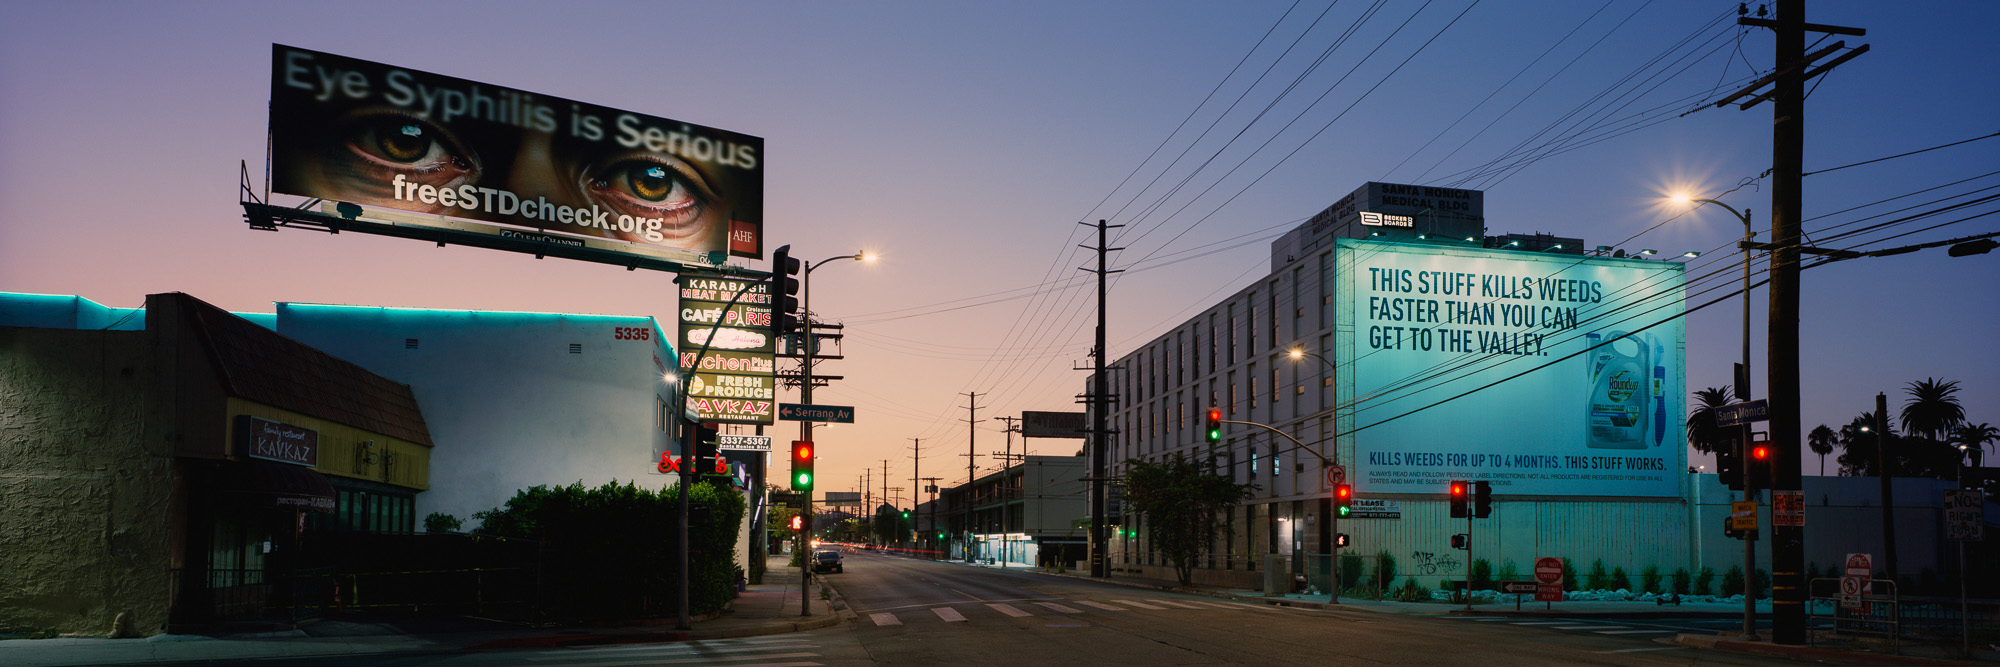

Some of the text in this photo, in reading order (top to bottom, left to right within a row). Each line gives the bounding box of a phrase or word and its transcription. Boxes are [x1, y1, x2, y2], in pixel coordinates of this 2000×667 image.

[284, 50, 757, 170] Eye Syphilis is Serious
[1381, 184, 1470, 200] SANTA MONICA
[393, 173, 664, 241] freeSTDcheck.org
[1381, 196, 1470, 211] MEDICAL BLDG
[732, 229, 753, 243] AHF
[1369, 266, 1602, 304] THIS STUFF KILLS WEEDS
[681, 288, 772, 304] MEAT MARKET
[681, 307, 723, 323] CAFÉ
[1369, 296, 1578, 330] FASTER THAN YOU CAN
[614, 327, 650, 341] 5335
[1369, 325, 1549, 357] GET TO THE VALLEY.
[751, 357, 773, 368] Plus
[716, 375, 763, 388] FRESH
[1609, 376, 1639, 392] Roundup
[705, 385, 773, 399] PRODUCE
[698, 398, 771, 415] AVKAZ
[795, 407, 850, 420] Serrano Av
[1718, 406, 1767, 421] Santa Monica
[258, 437, 310, 461] KAVKAZ
[720, 436, 769, 446] 5337-5367
[1369, 451, 1667, 471] KILLS WEEDS FOR UP TO 4 MONTHS. THIS STUFF WORKS.
[1953, 495, 1972, 508] NO
